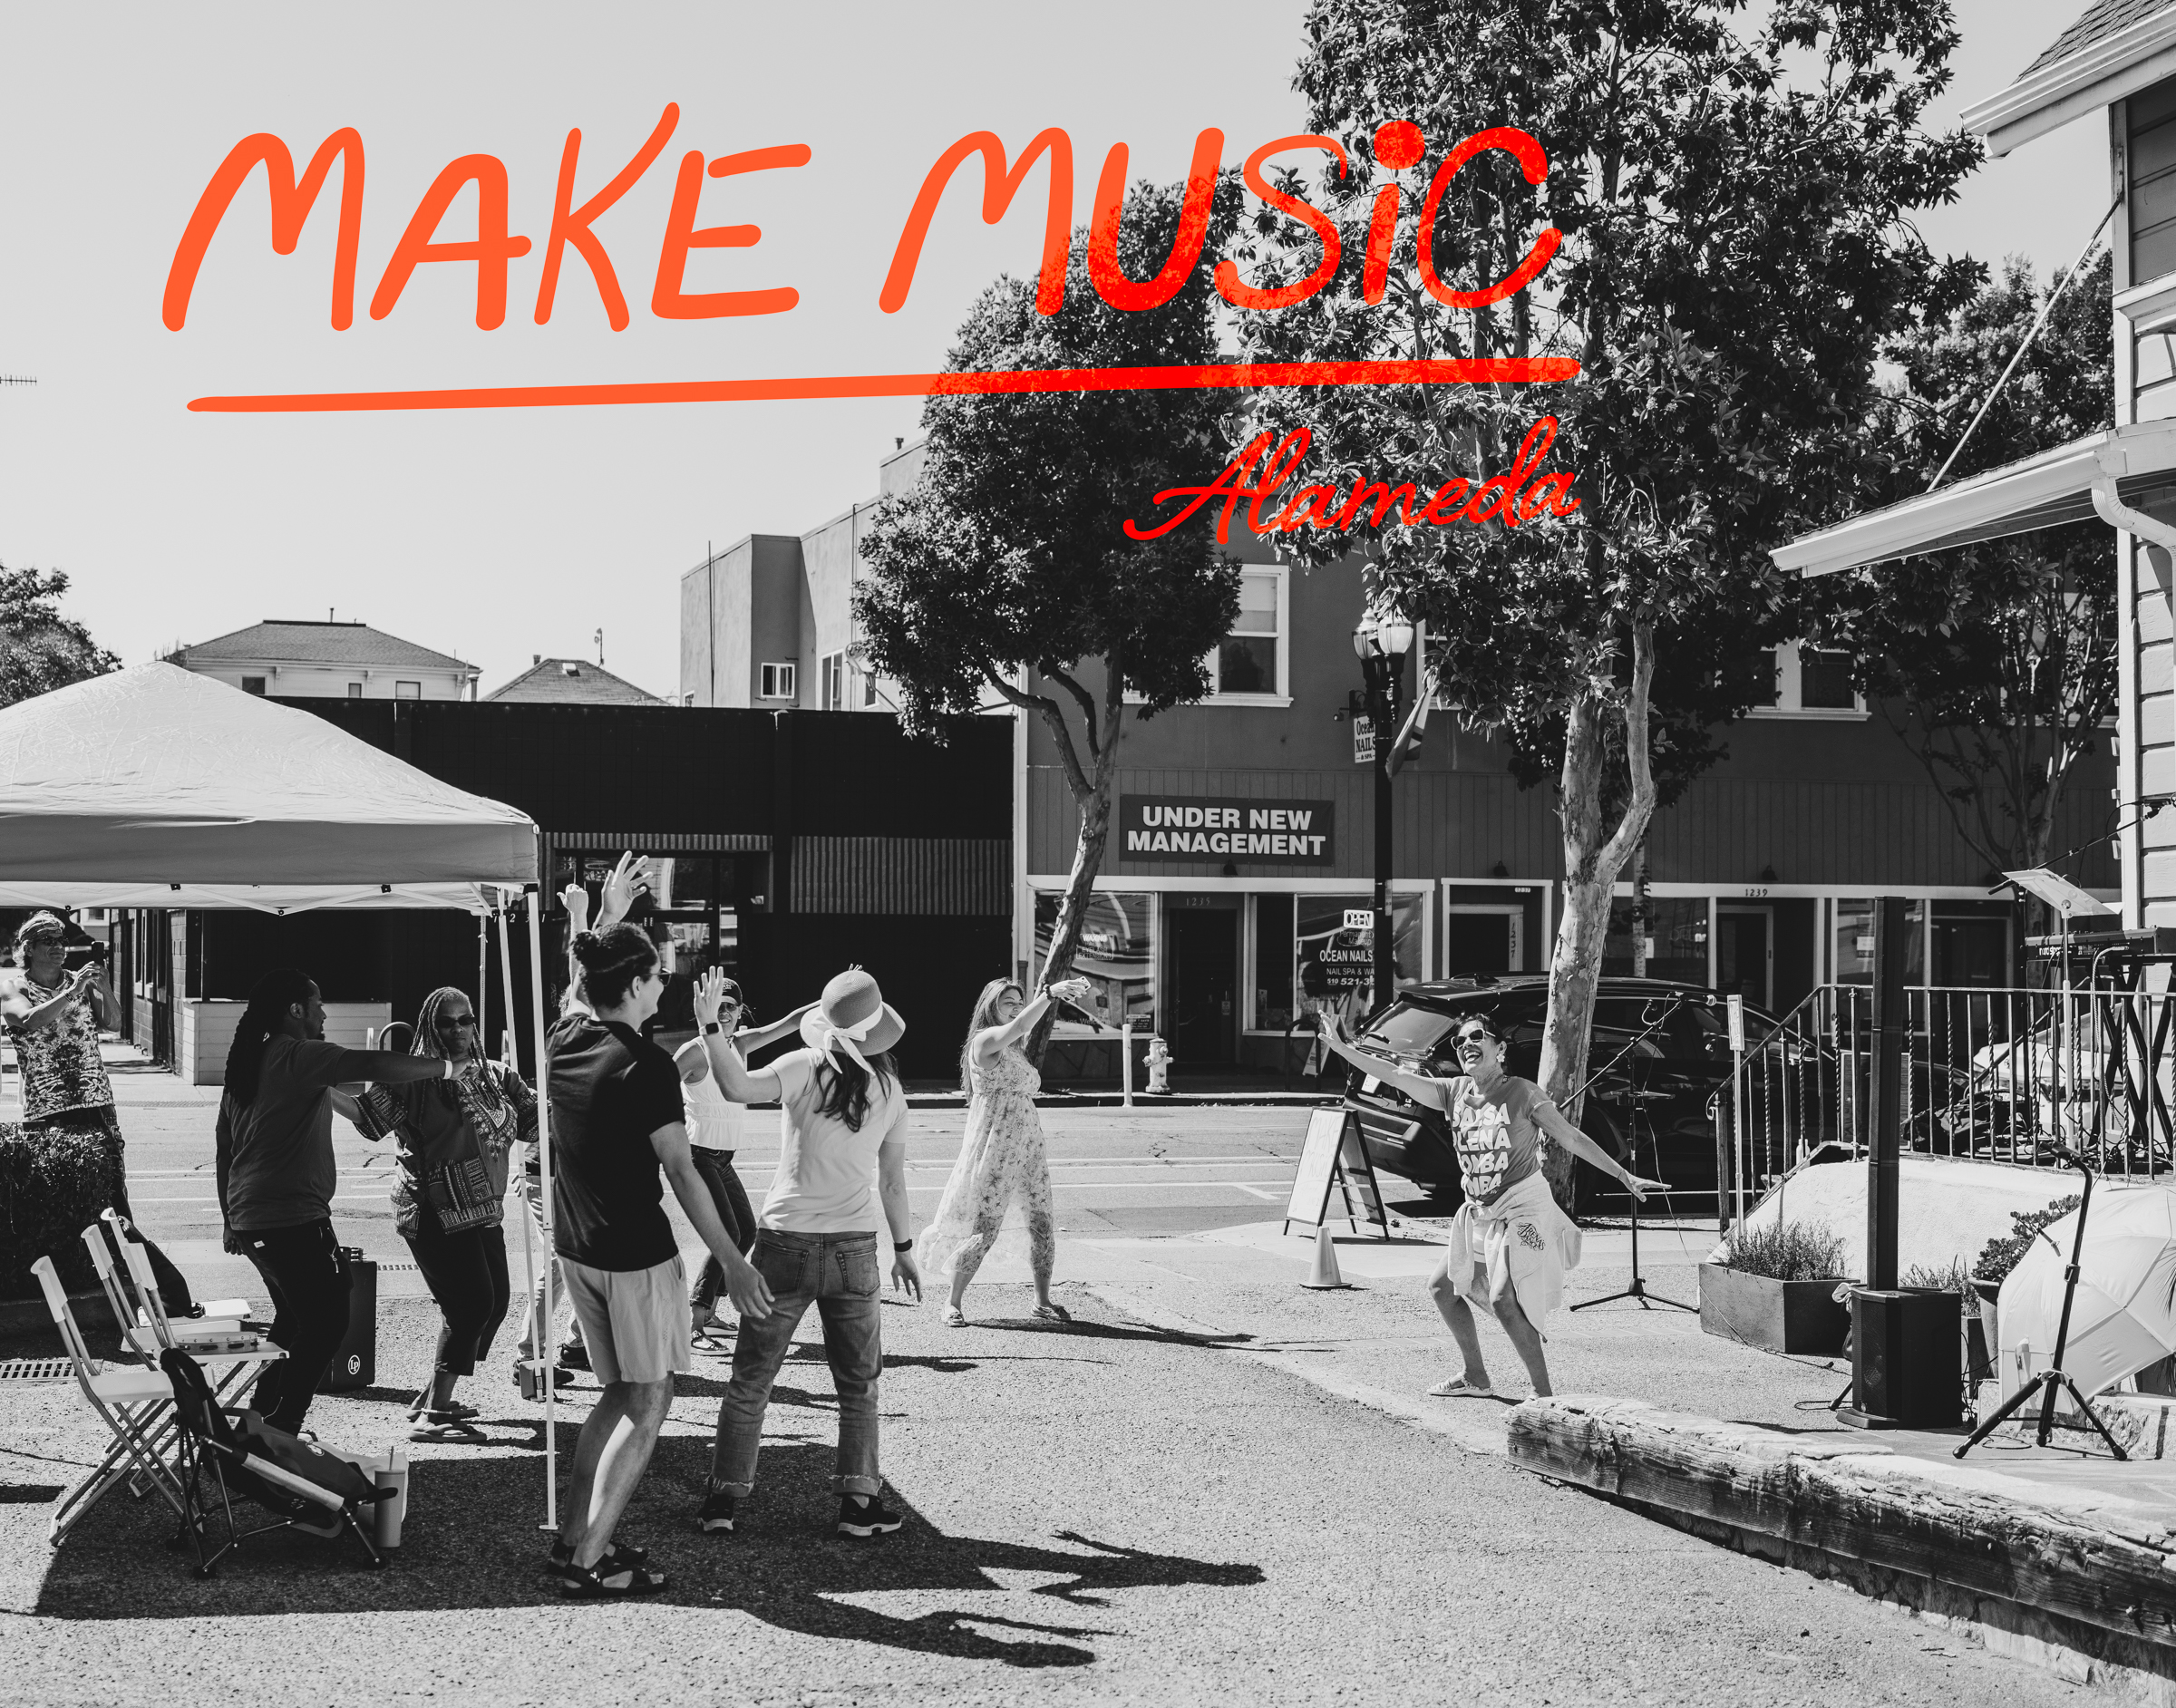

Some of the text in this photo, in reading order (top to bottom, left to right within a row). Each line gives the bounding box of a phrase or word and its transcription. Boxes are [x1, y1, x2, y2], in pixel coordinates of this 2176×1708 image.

[1355, 737, 1375, 752] NAILS
[1142, 805, 1313, 830] UNDER NEW
[1127, 830, 1326, 856] MANAGEMENT
[1745, 888, 1768, 897] 1239
[1186, 897, 1210, 907] 1235
[1345, 912, 1371, 926] OPEN
[1319, 950, 1374, 962] OCEAN NAILS
[1326, 967, 1341, 975] NAIL
[1343, 967, 1355, 975] SPA
[1452, 1102, 1511, 1128] SALSA
[1452, 1127, 1512, 1151] LENA
[1459, 1151, 1509, 1174] OMBA
